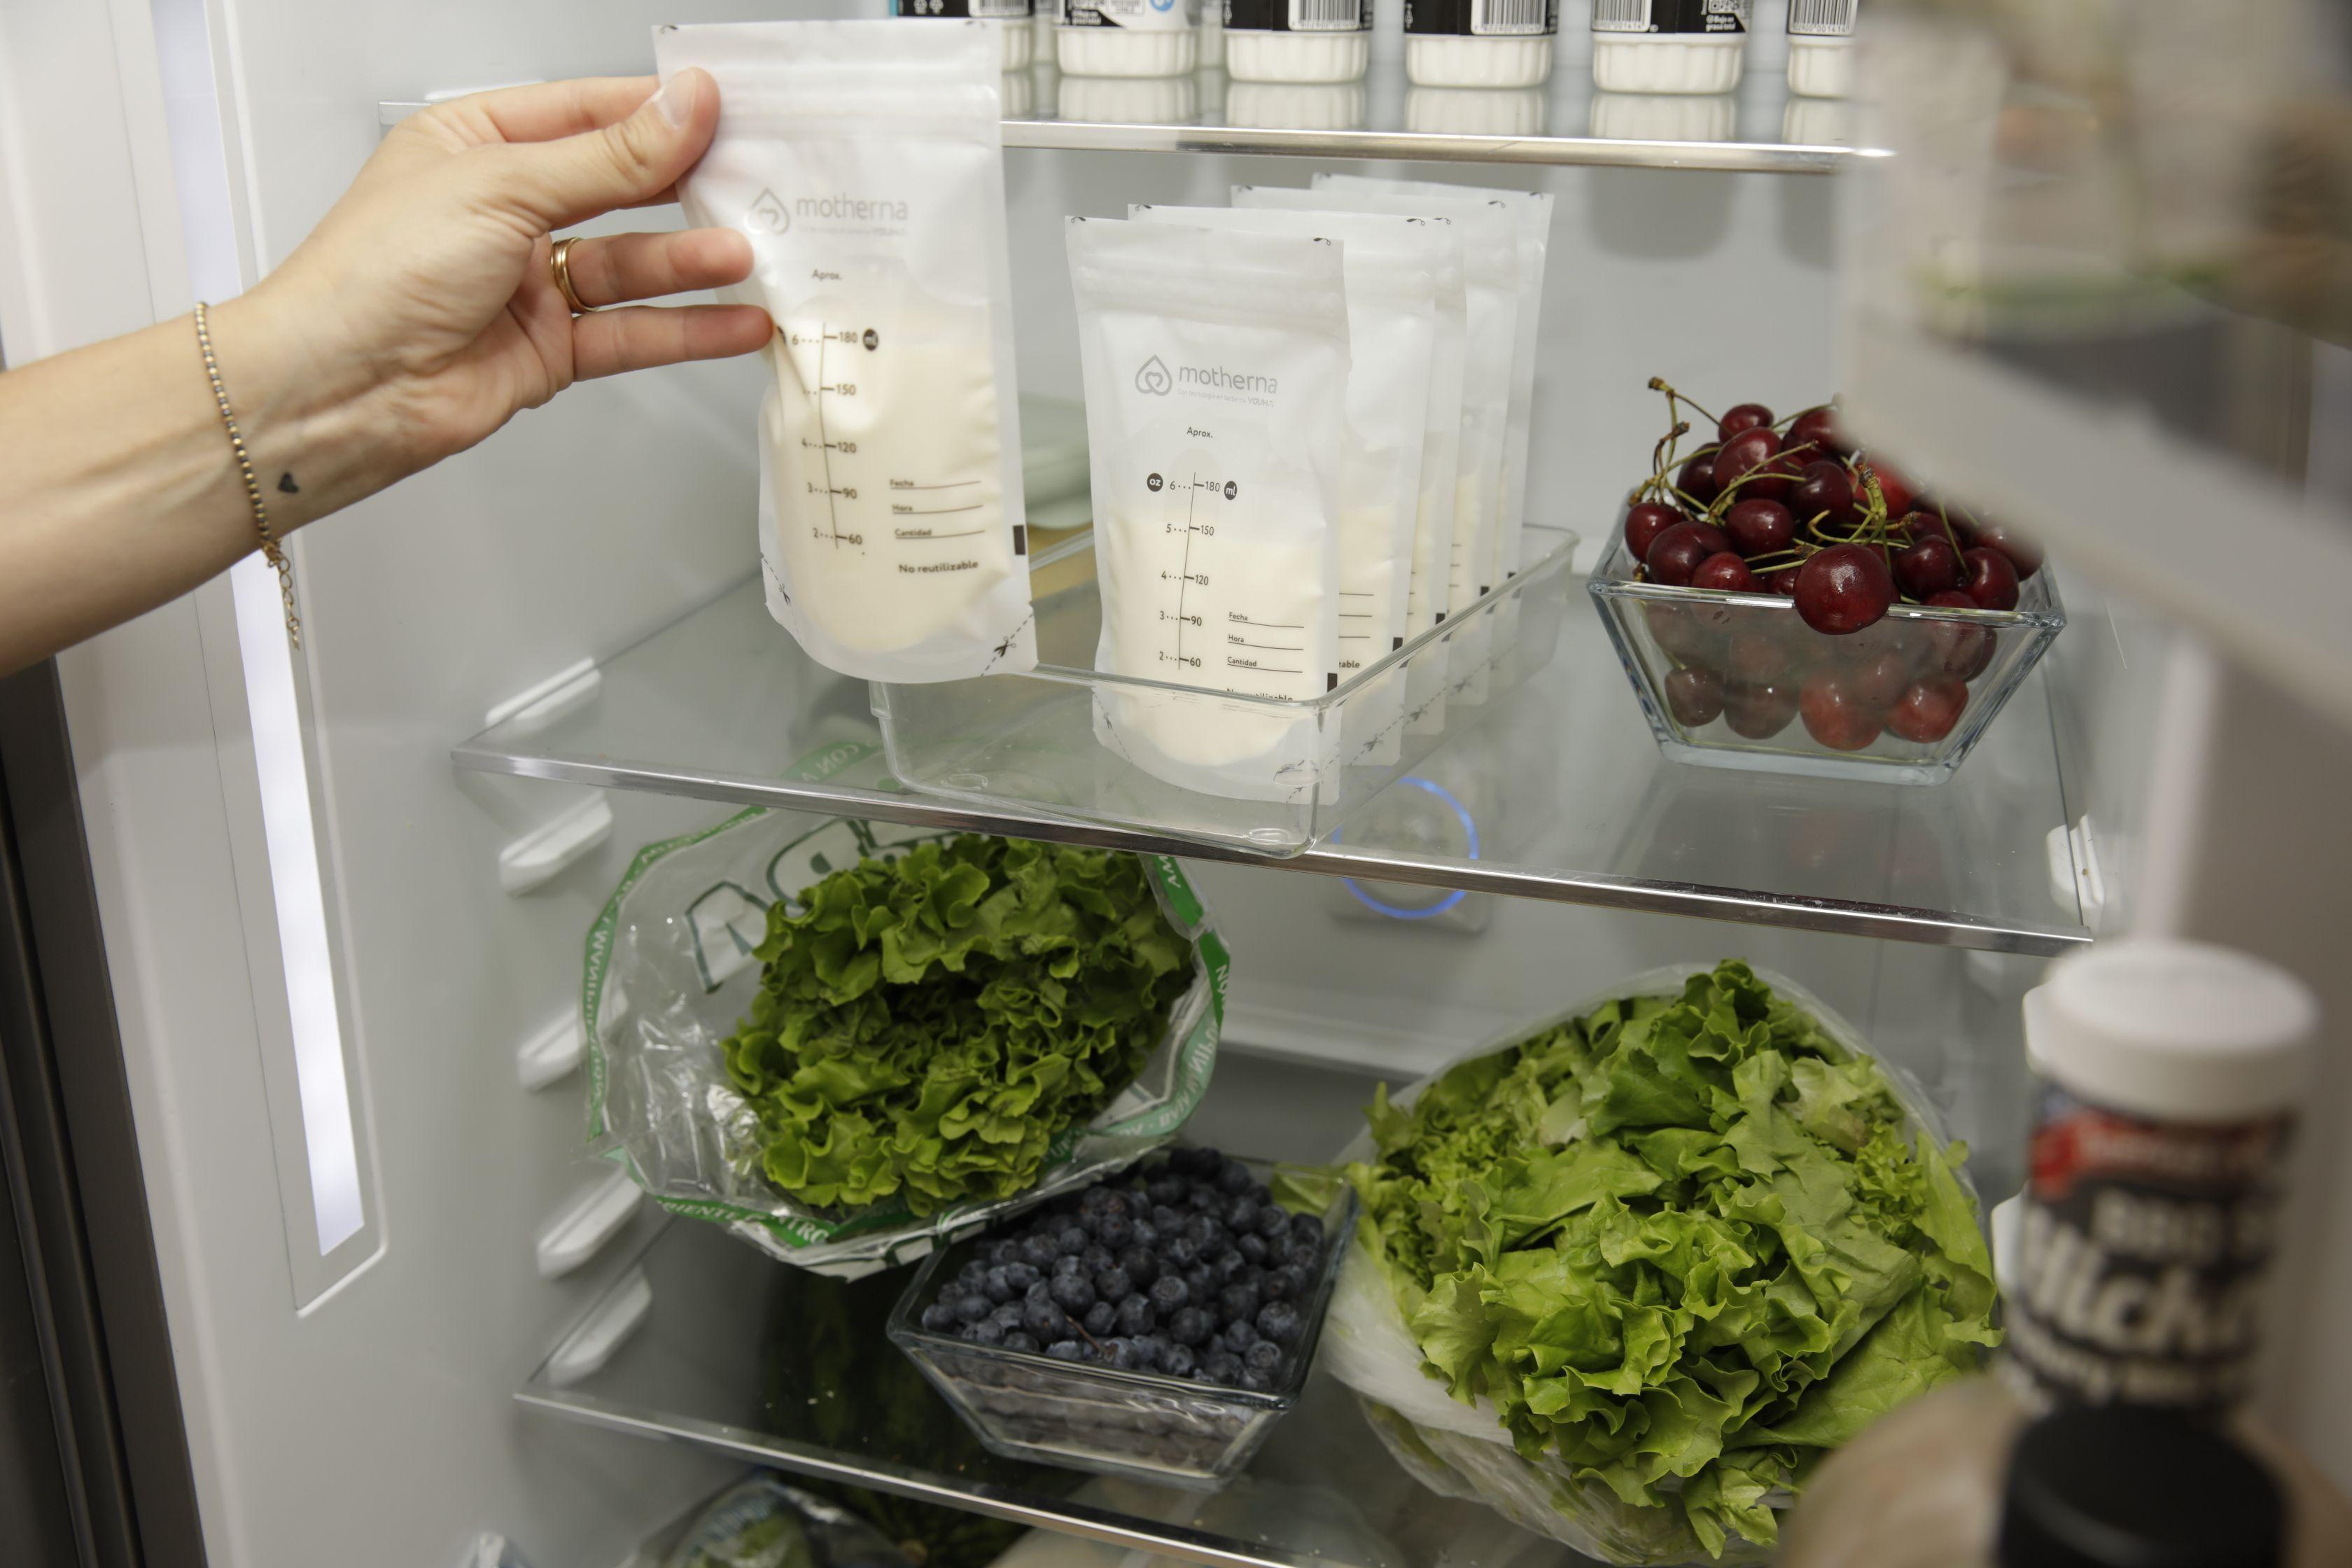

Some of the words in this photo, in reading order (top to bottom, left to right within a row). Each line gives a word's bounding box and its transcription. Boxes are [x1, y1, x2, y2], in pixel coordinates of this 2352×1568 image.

[796, 192, 909, 220] motherna
[792, 334, 799, 346] 6
[840, 332, 858, 344] 180
[1179, 366, 1278, 394] motherna
[836, 384, 856, 396] 150
[1186, 426, 1213, 438] Aprox.
[838, 442, 857, 454] 120
[807, 482, 813, 493] 3
[889, 478, 915, 486] Fecha
[1149, 478, 1161, 486] oz
[1170, 480, 1176, 491] 6
[1205, 480, 1220, 492] 180
[842, 488, 858, 499] 90
[813, 527, 818, 538] 2
[895, 528, 932, 537] Cantidad
[1166, 524, 1172, 533] 5
[1200, 525, 1214, 536] 150
[848, 534, 862, 545] 60
[899, 564, 915, 573] No
[918, 560, 979, 573] reutilizable
[1161, 570, 1167, 580] 4
[1196, 574, 1209, 586] 120
[1159, 610, 1165, 621] 3
[1191, 615, 1203, 626] 90
[1228, 612, 1248, 621] Fecha
[1228, 634, 1245, 643] Hora
[1159, 651, 1164, 661] 2
[1227, 656, 1257, 667] Cantidad
[1189, 657, 1201, 668] 60
